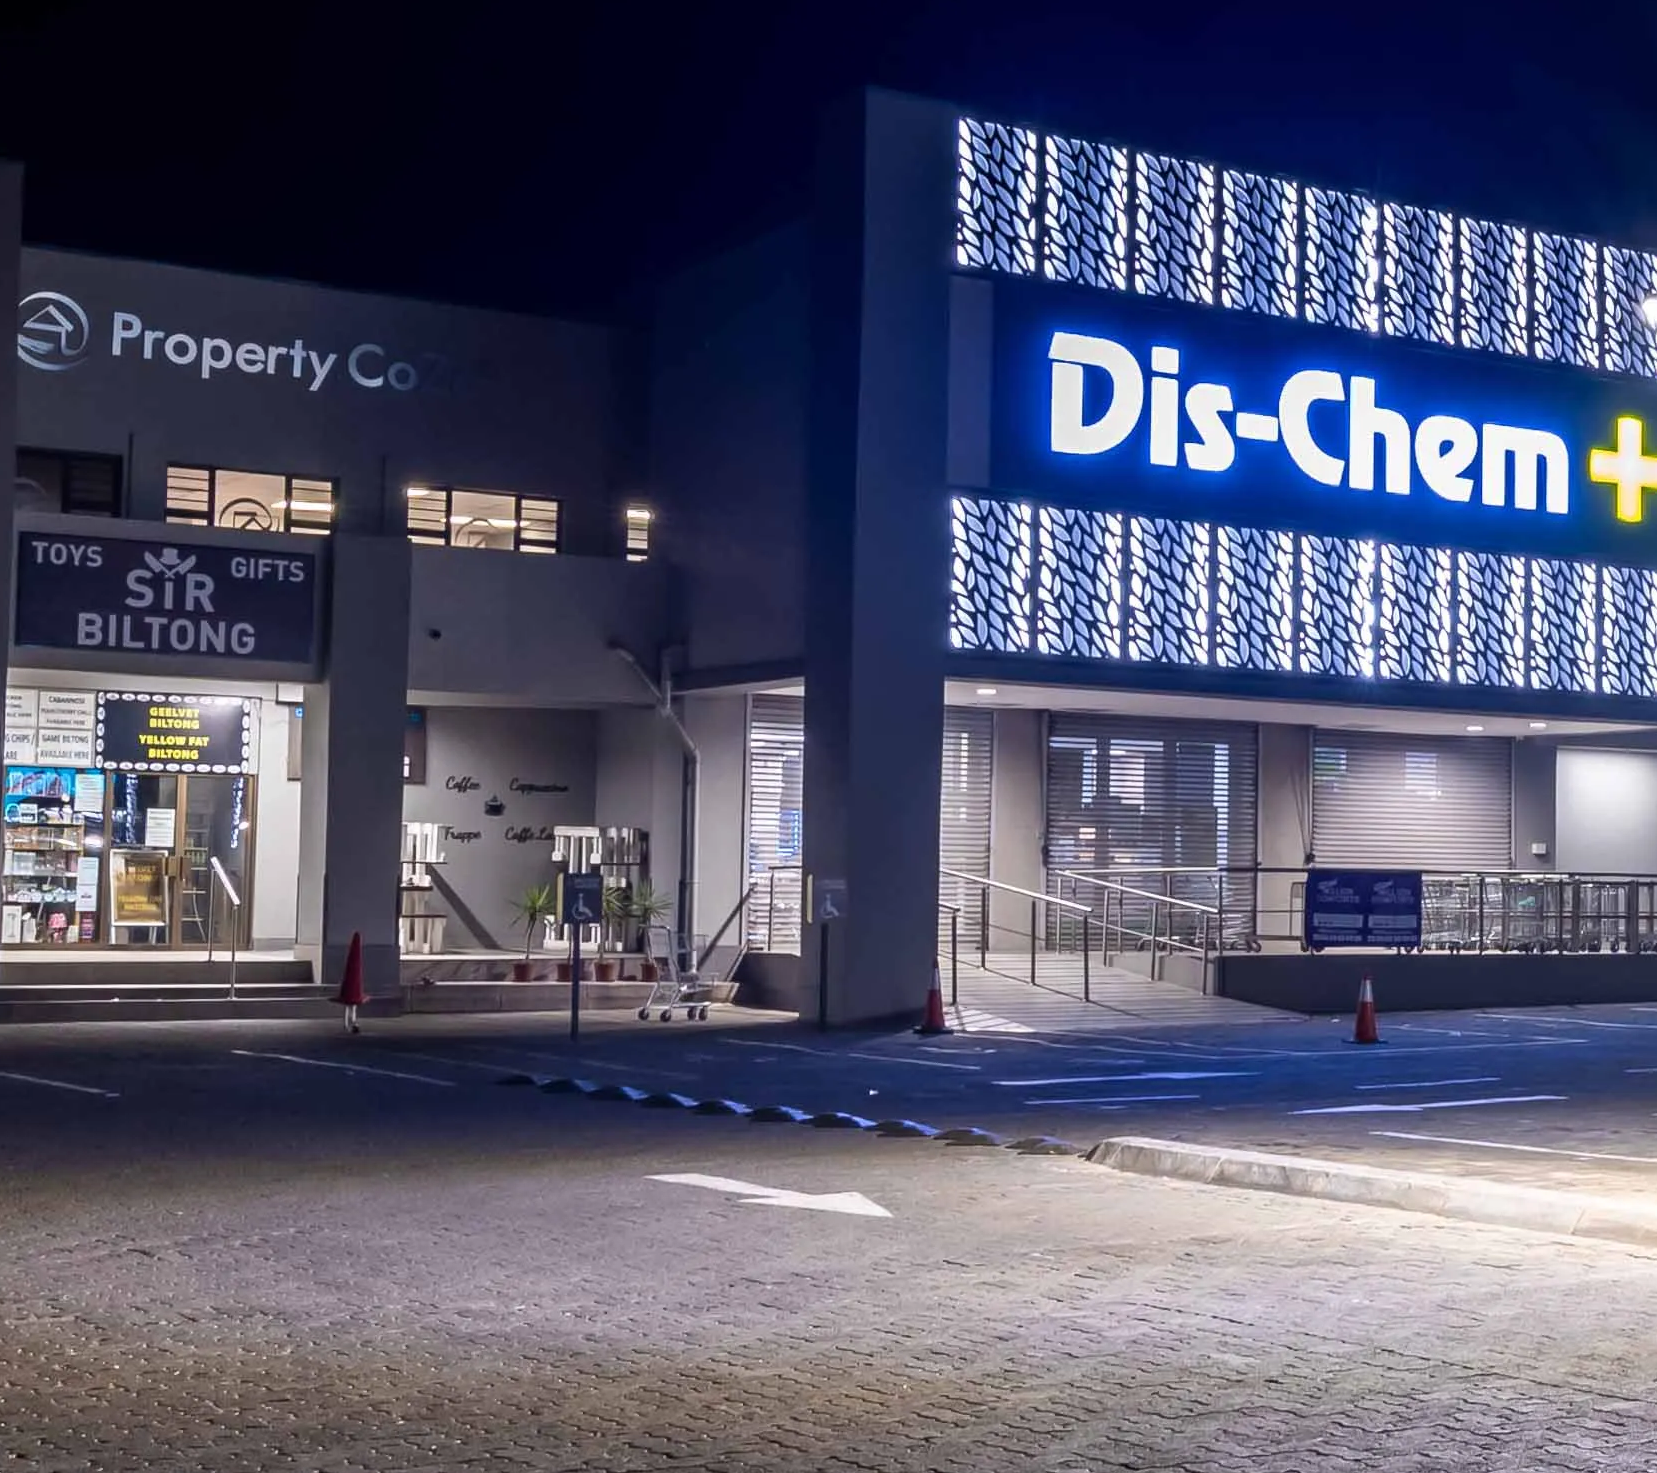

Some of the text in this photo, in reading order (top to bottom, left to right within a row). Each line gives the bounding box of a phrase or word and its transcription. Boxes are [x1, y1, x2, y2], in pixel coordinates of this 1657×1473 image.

[111, 311, 338, 391] Property
[1048, 331, 1570, 515] Dis-Chem
[31, 541, 103, 567] TOYS
[230, 557, 305, 582] GIFTS
[77, 612, 256, 655] BILTONG
[149, 718, 200, 729] BILTONG
[138, 734, 210, 747] YELLOW FAT
[148, 748, 199, 760] BILTONG
